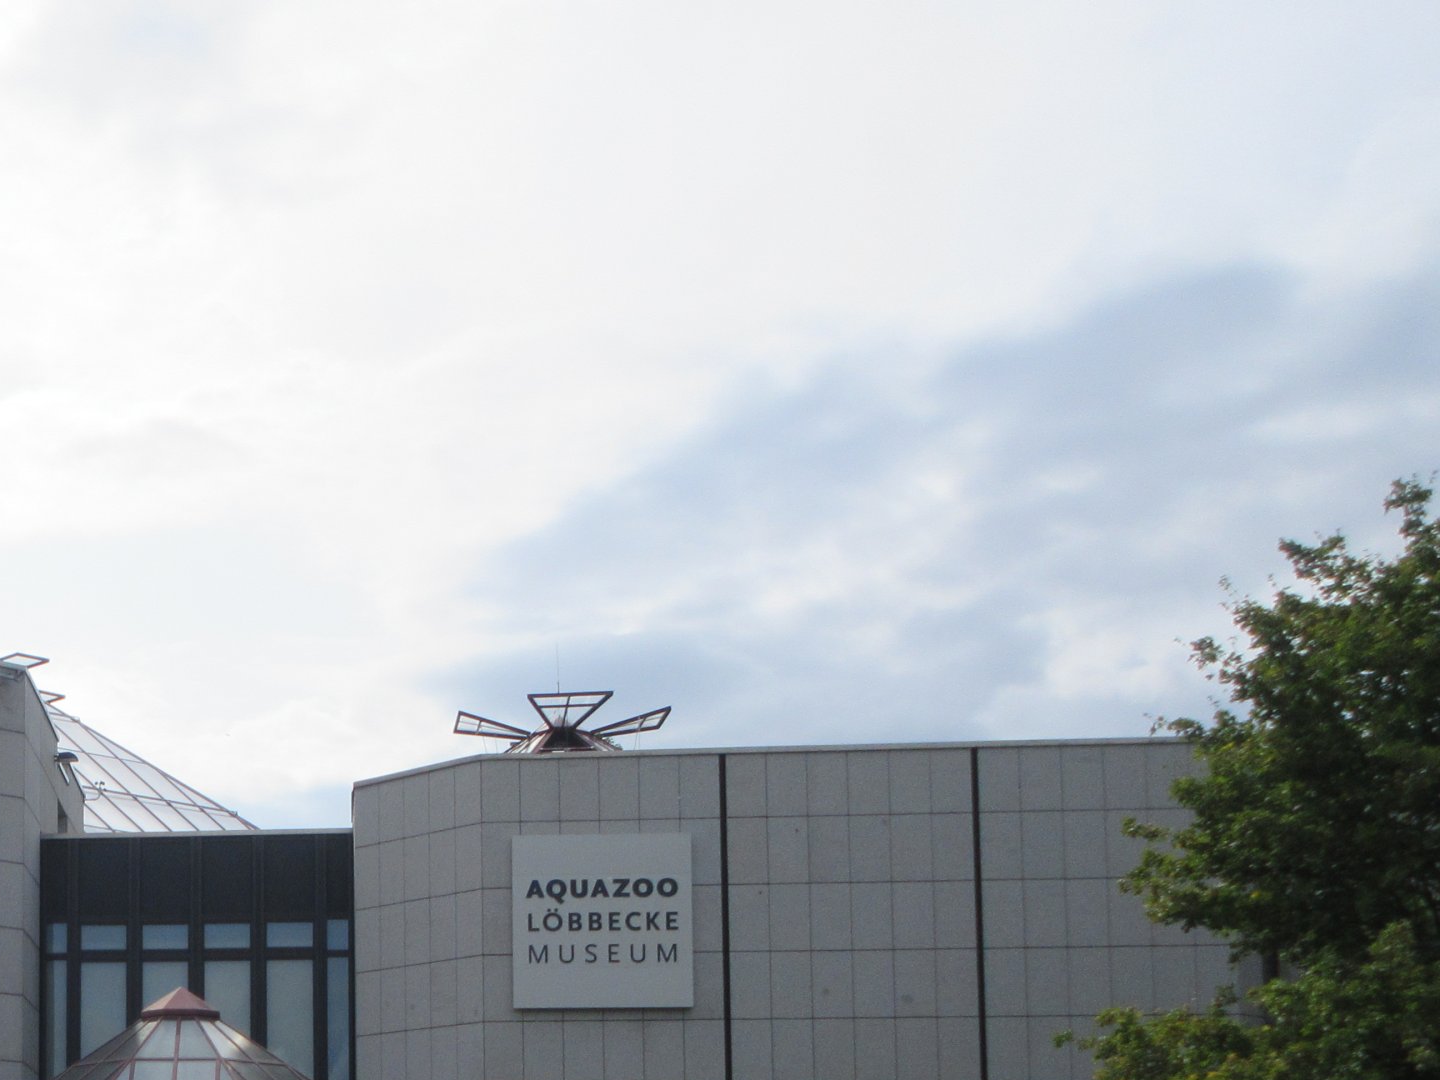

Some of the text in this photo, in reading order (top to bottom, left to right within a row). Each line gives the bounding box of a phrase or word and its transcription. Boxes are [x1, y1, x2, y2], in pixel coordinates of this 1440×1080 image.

[526, 878, 679, 904] AQUAZOO
[527, 908, 679, 932] LÖBBECKE
[528, 943, 678, 964] MUSEUM
